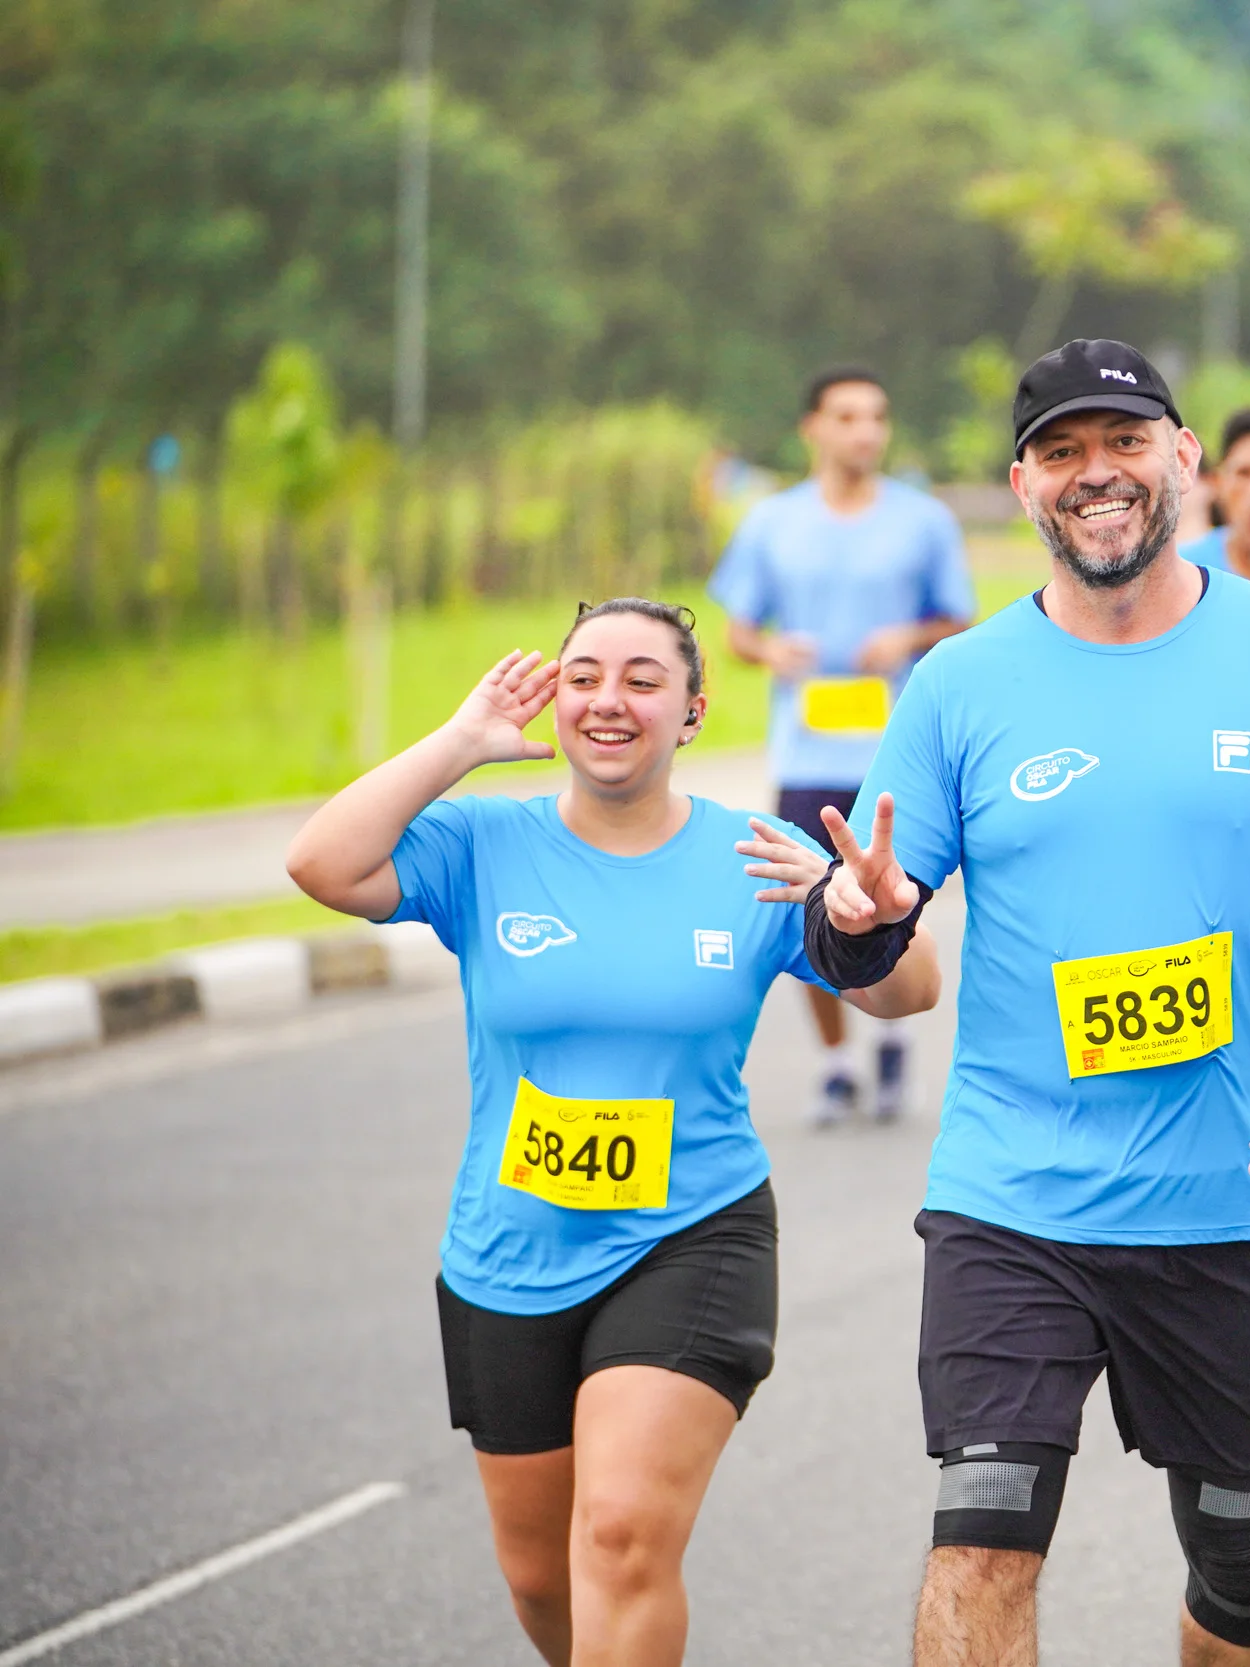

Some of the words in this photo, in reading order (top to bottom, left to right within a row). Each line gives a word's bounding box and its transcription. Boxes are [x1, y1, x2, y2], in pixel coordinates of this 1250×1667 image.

[1100, 368, 1138, 385] FILA
[1025, 756, 1071, 776] CIRCUITO
[1026, 766, 1060, 782] OSCAR
[1026, 777, 1048, 790] FILA
[512, 919, 552, 932] CIRCUITO
[1165, 955, 1191, 969] FILA
[1087, 967, 1122, 981] OSCAR
[1084, 977, 1211, 1045] 5839
[1067, 1020, 1075, 1029] A
[1119, 1043, 1150, 1053] MARCIO
[1151, 1035, 1189, 1049] SAMPAIO
[1141, 1048, 1183, 1061] MASCULINO
[594, 1111, 621, 1121] FILA
[523, 1119, 637, 1182] 5840
